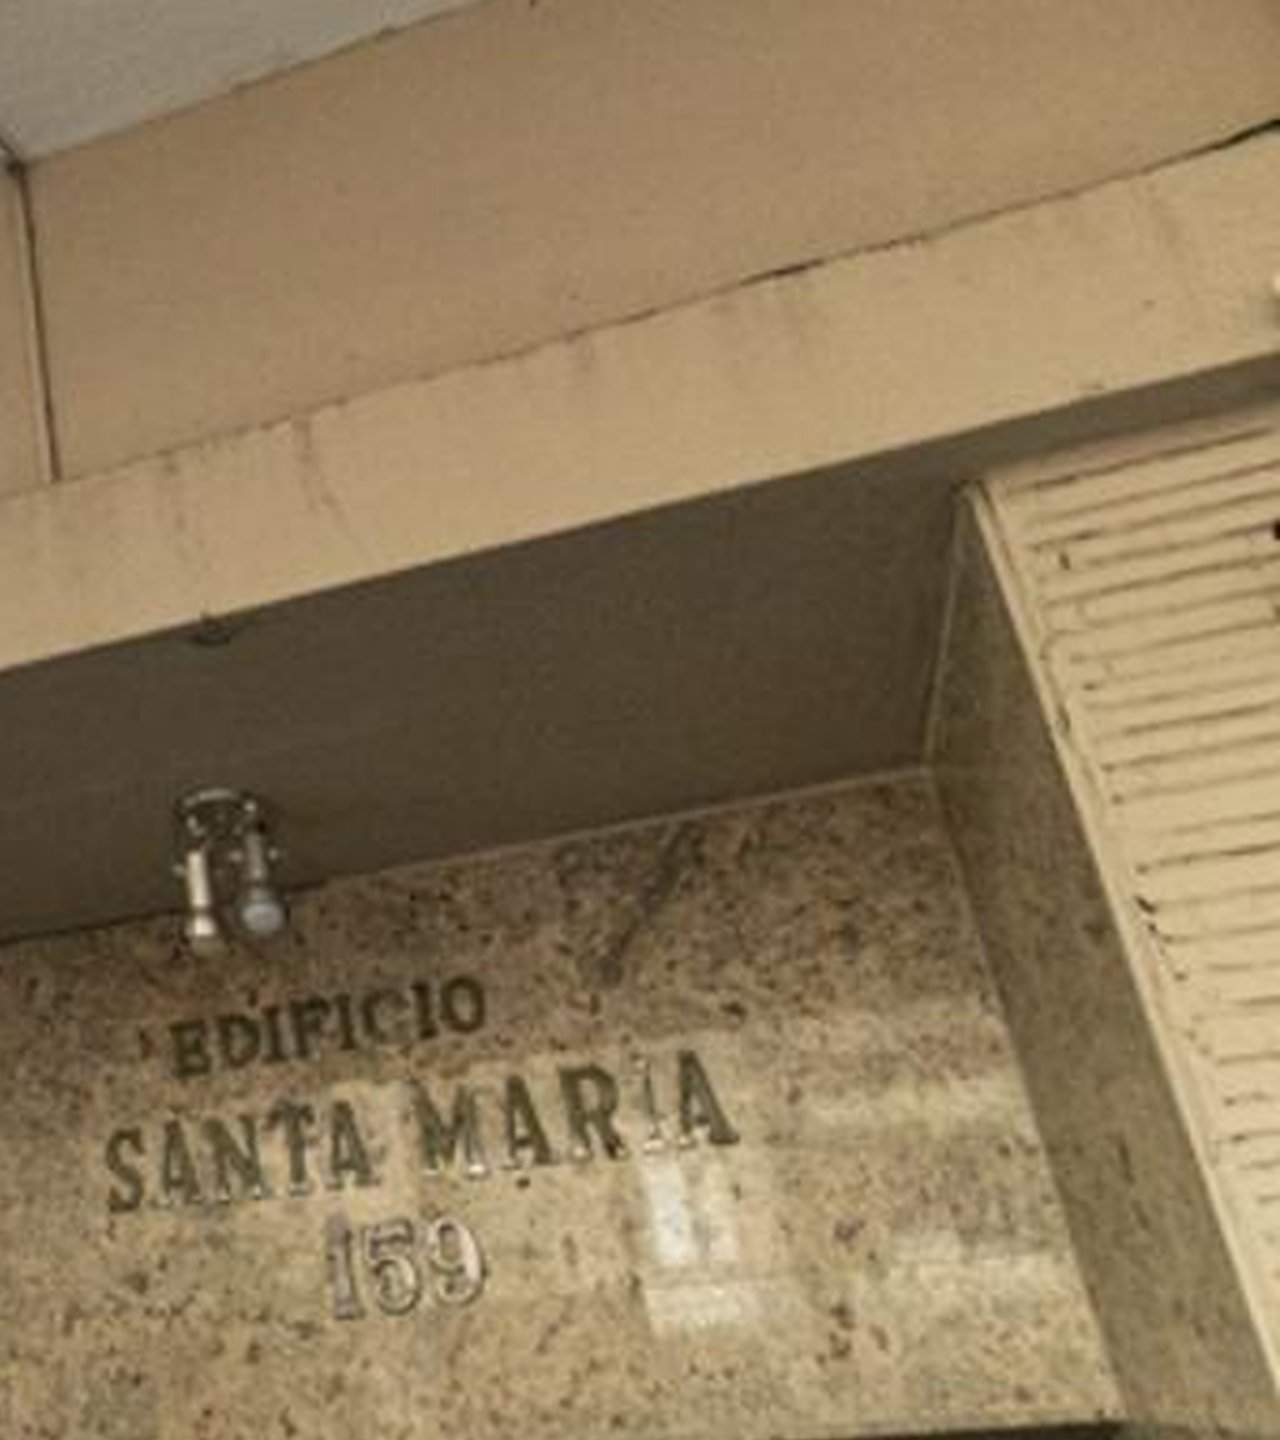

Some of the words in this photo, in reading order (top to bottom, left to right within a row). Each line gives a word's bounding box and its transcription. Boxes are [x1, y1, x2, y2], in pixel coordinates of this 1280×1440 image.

[168, 976, 486, 1077] EDIFICIO
[104, 1098, 381, 1213] SANTA
[408, 1049, 741, 1180] MARIA
[324, 1212, 486, 1321] 159
